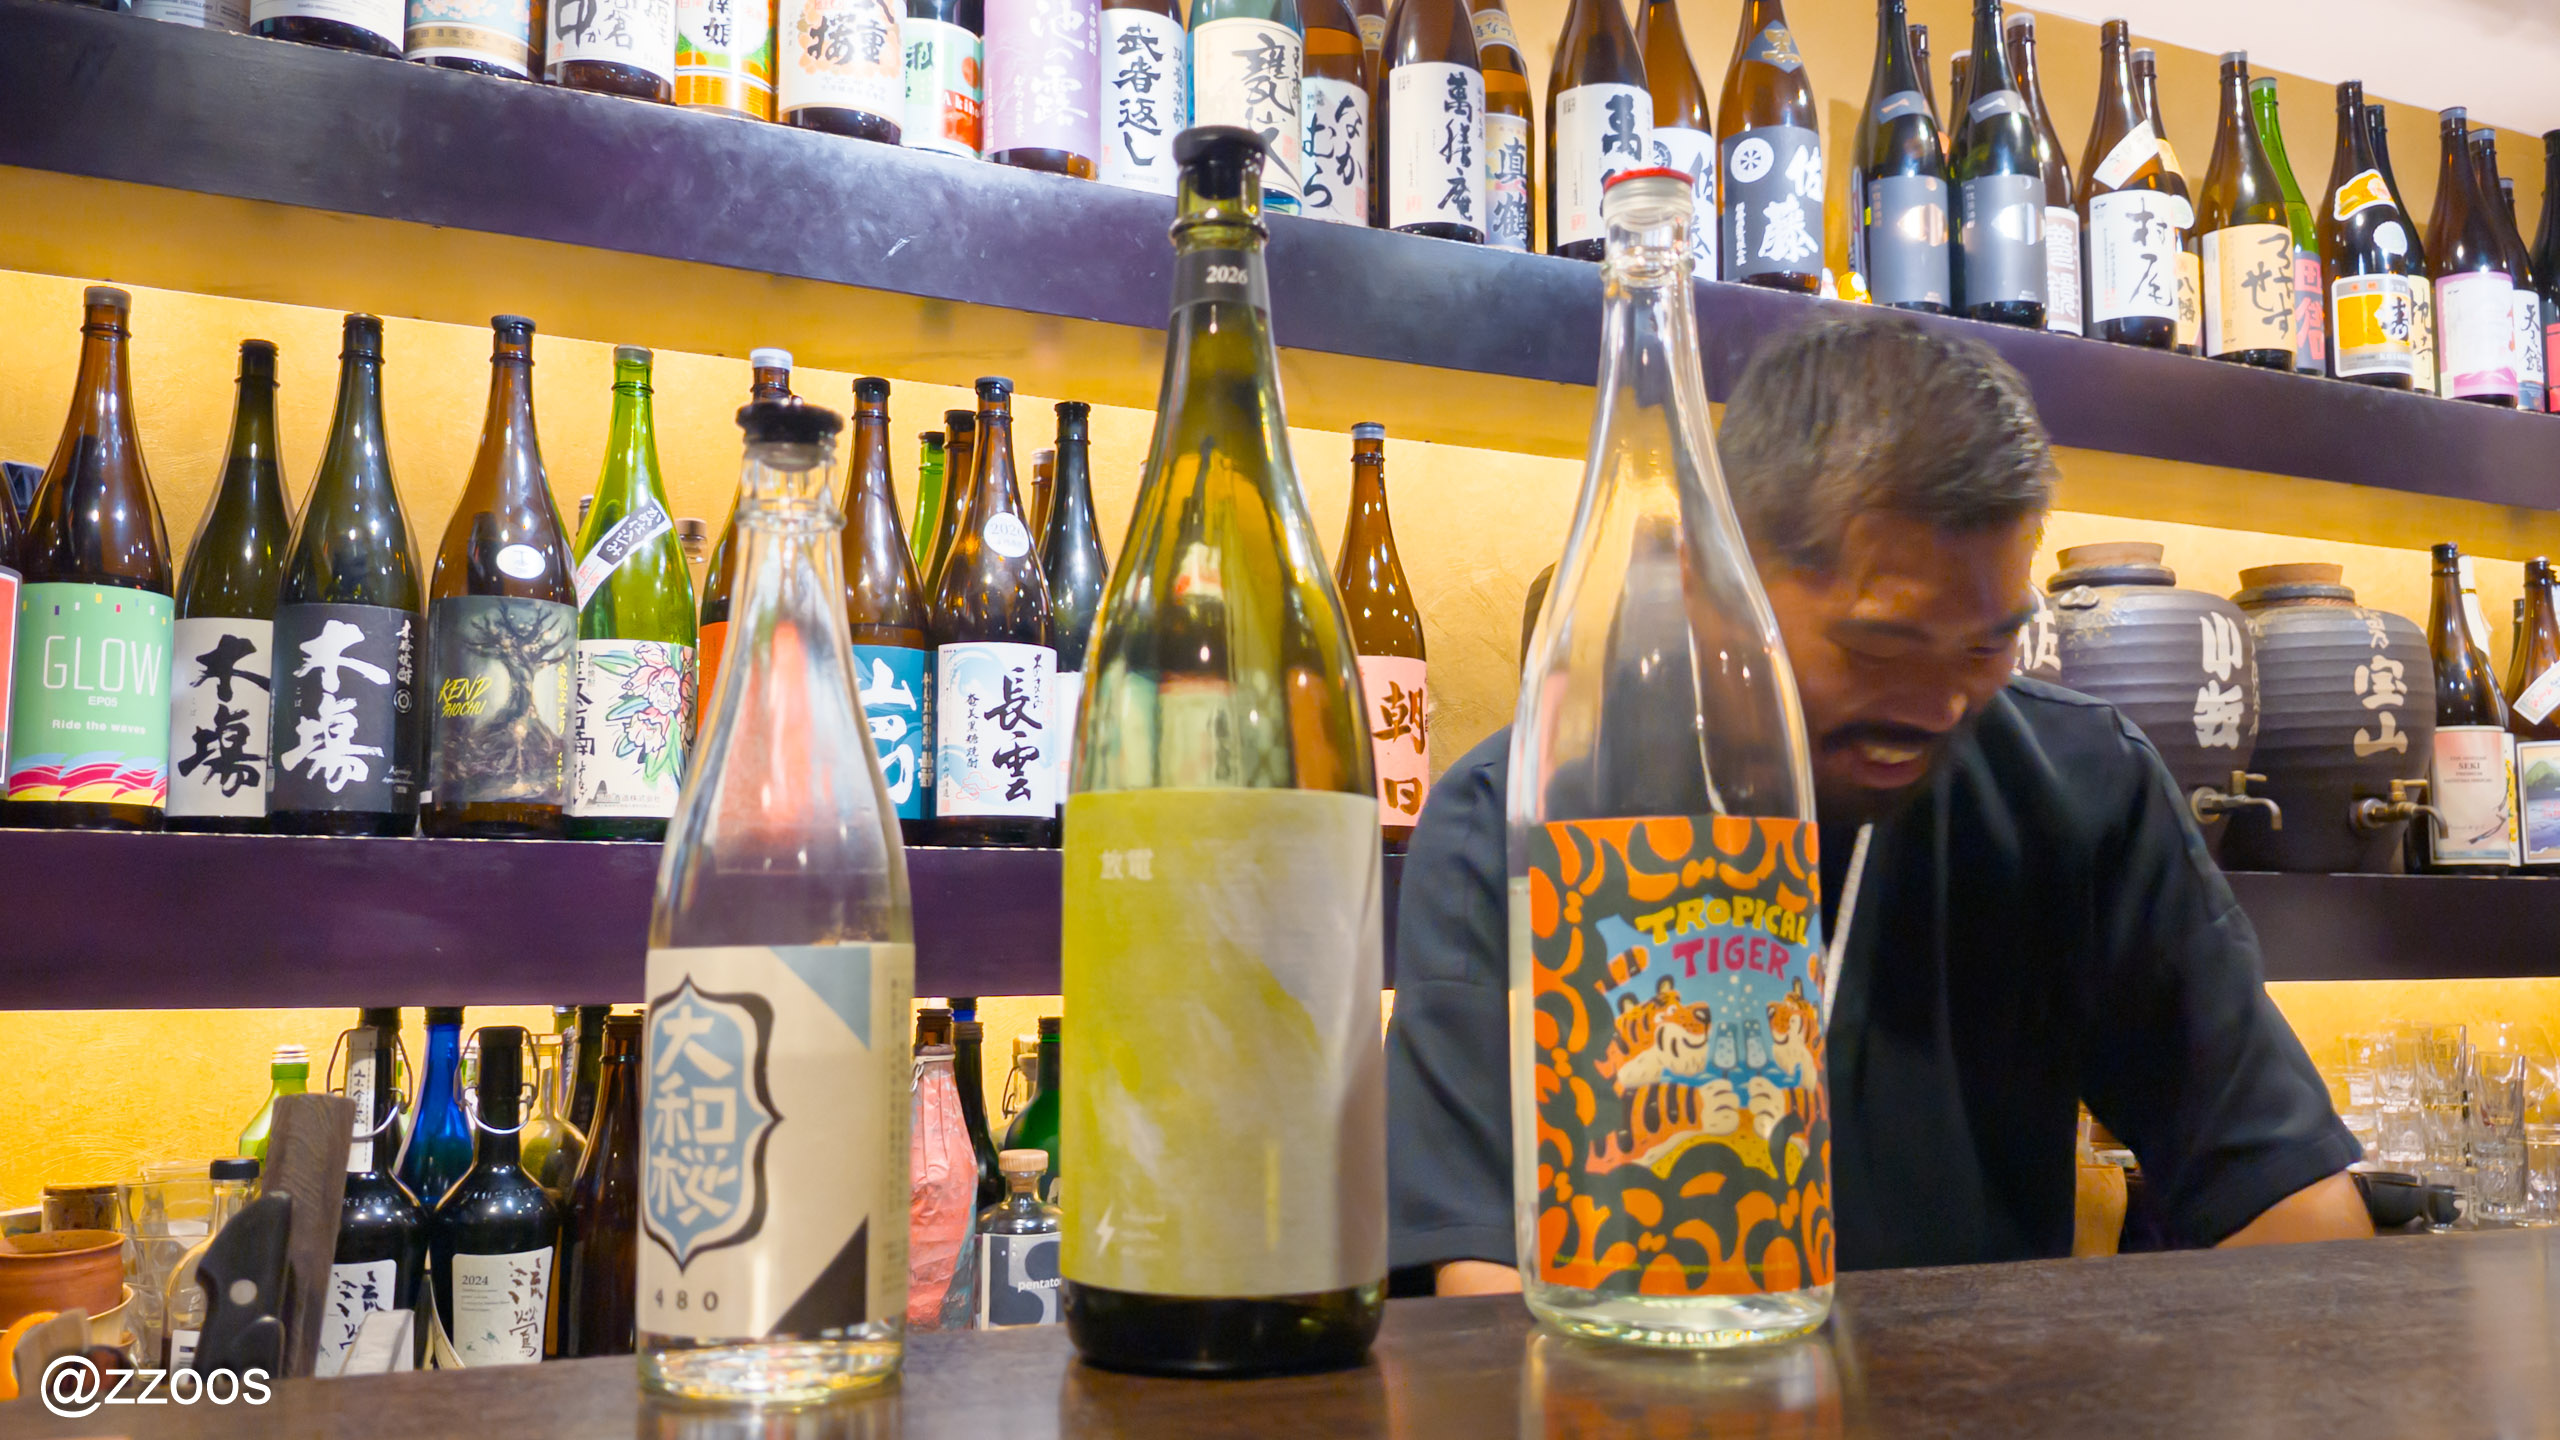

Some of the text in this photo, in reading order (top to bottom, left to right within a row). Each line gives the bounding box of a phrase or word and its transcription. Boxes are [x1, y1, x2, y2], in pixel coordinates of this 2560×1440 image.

[1112, 23, 1164, 166] 武者返し
[1494, 136, 1527, 246] 真鶴
[1757, 144, 1823, 264] 佐藤
[1206, 264, 1248, 284] 2026
[2125, 196, 2174, 307] 村尾
[43, 635, 163, 697] GLOW
[51, 719, 147, 735] Ride the waves
[984, 666, 1043, 802] 長雲
[1372, 680, 1426, 816] 朝日
[1635, 896, 1809, 947] TROPICAL
[1672, 936, 1791, 980] TIGER
[649, 1004, 739, 1228] 大和桜
[461, 1274, 489, 1287] 2024
